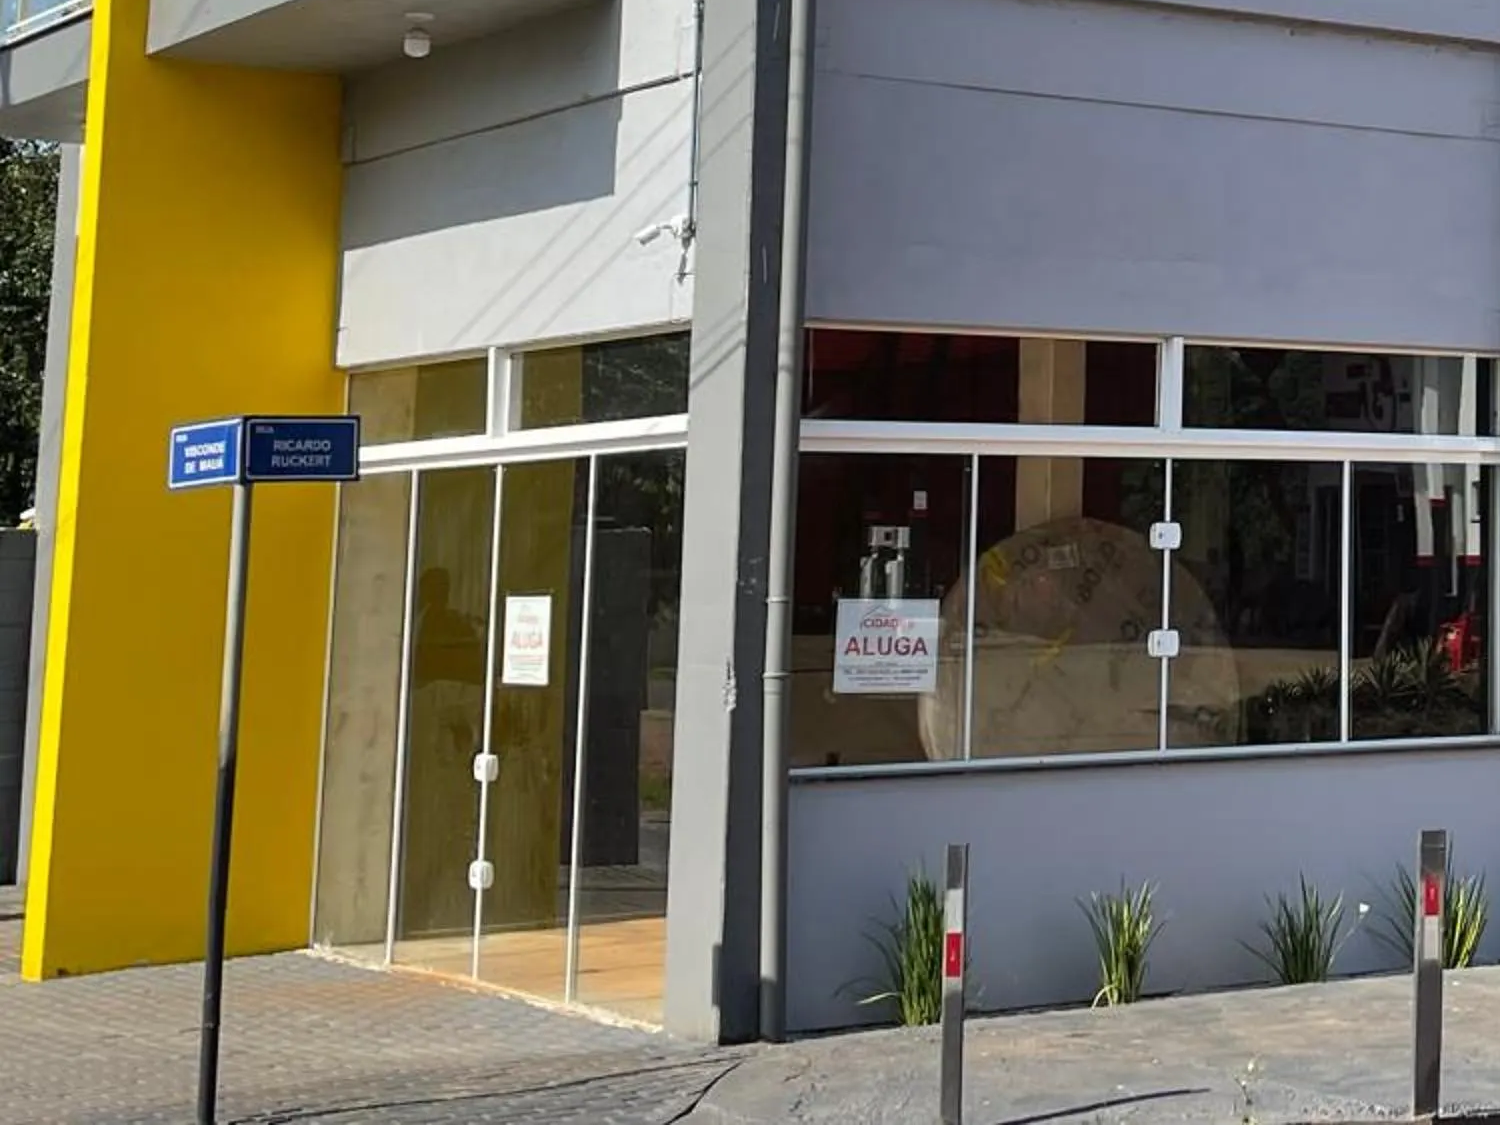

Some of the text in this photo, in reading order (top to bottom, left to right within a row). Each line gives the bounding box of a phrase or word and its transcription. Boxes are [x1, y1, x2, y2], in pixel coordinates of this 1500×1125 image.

[273, 439, 331, 452] RICARDO
[271, 455, 332, 468] RUCKERT
[844, 636, 929, 656] ALUGA
